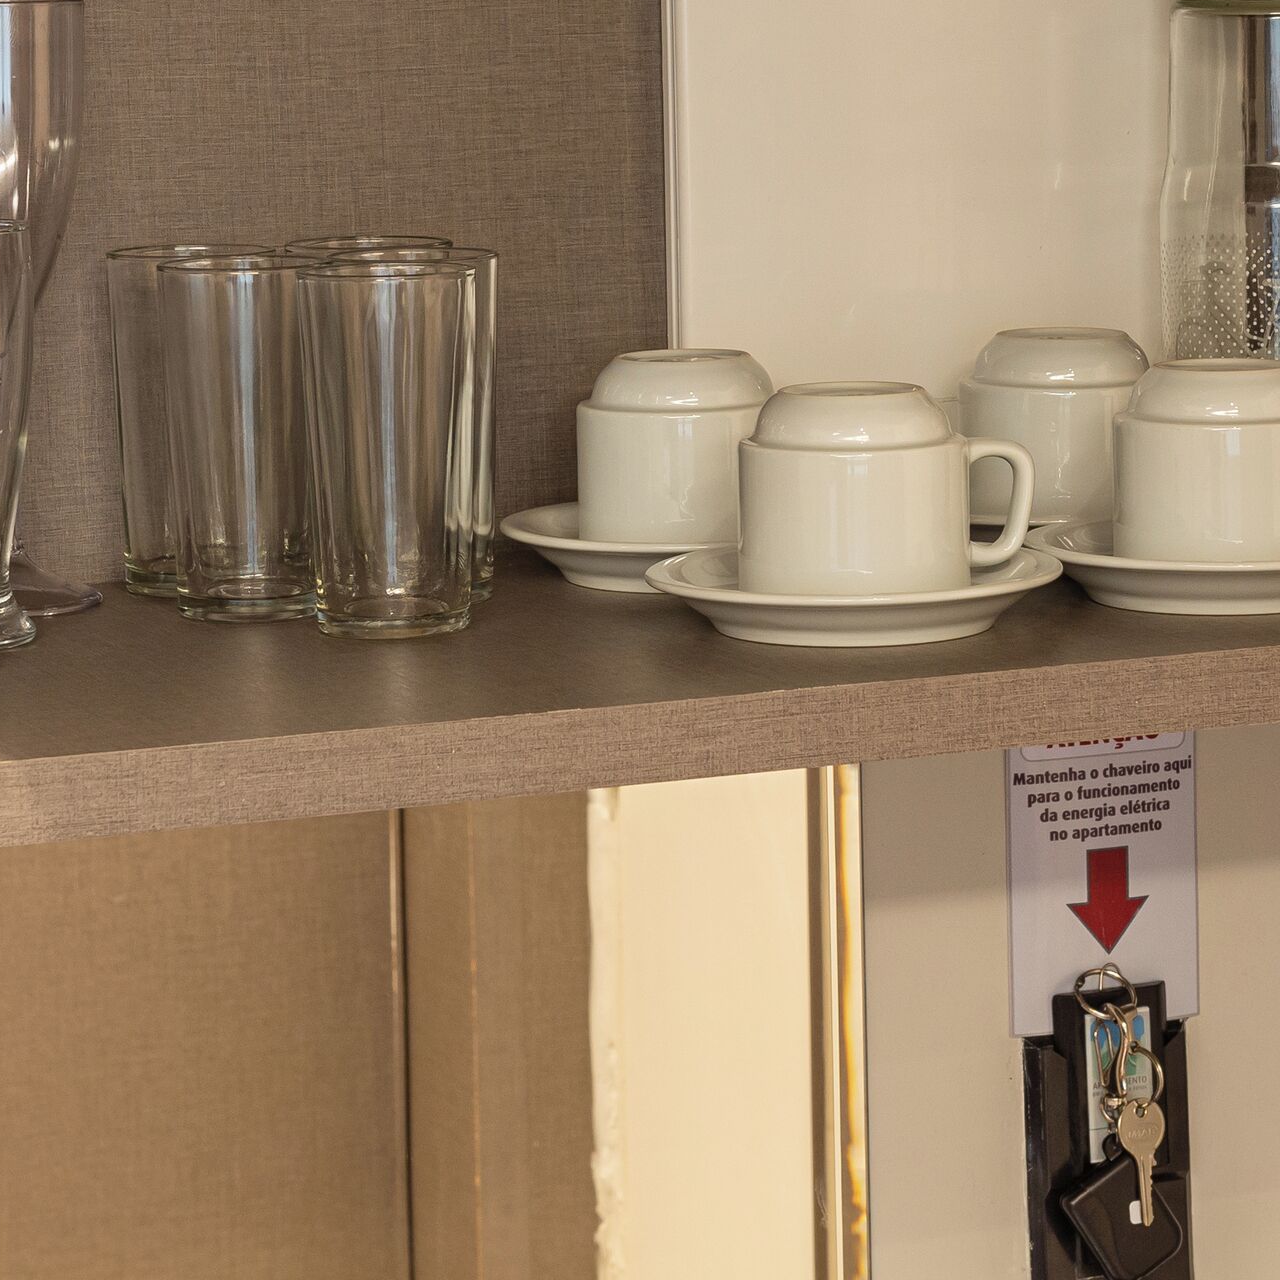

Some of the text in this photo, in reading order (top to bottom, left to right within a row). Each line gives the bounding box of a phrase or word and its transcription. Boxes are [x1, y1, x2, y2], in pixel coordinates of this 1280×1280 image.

[1013, 756, 1192, 786] Mantenha o chaveiro aqui
[1027, 778, 1180, 808] para o funcionamento
[1040, 798, 1170, 822] da energia elétrica
[1050, 818, 1162, 842] no apartamento
